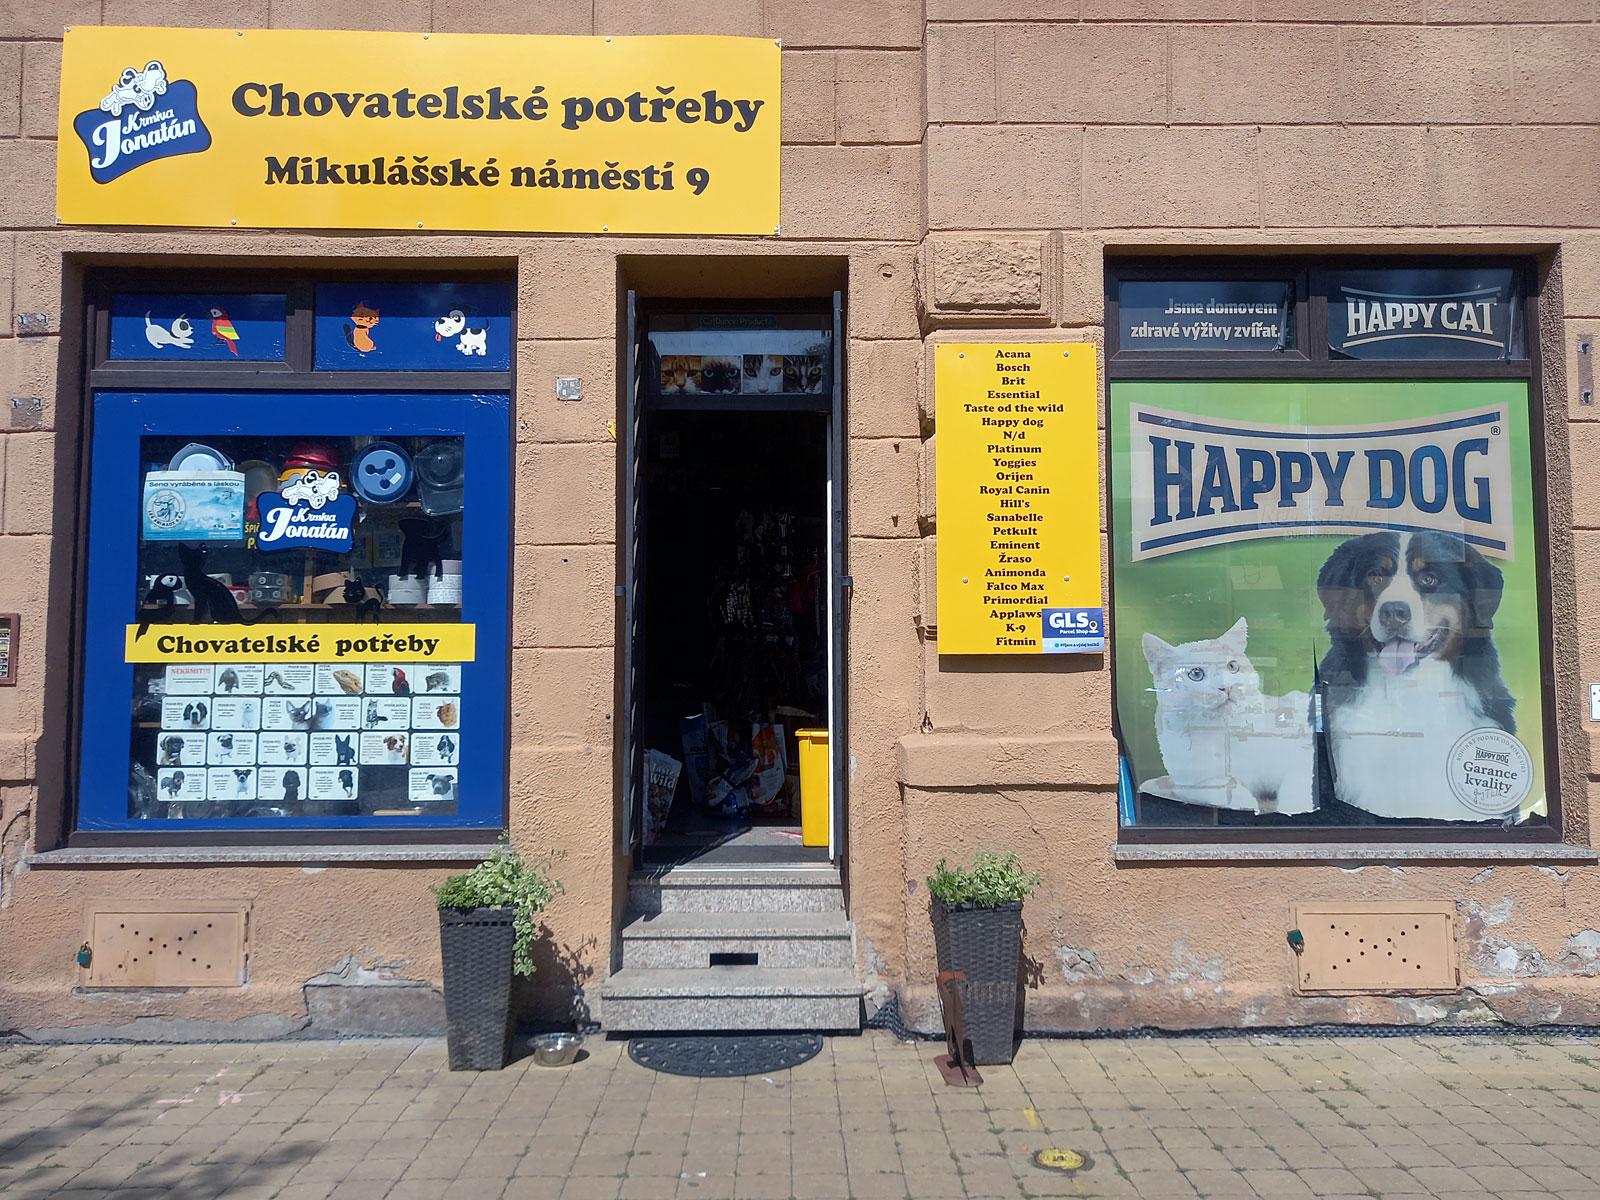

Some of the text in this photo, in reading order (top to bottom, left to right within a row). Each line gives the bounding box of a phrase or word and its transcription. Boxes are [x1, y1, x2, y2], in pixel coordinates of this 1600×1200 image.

[231, 82, 765, 133] Chovatelské potřeby
[122, 109, 175, 135] Krmiva
[91, 118, 197, 169] Jonatán
[264, 156, 711, 195] Mikulášské náměstí 9
[1164, 298, 1278, 314] Jsme domovem
[1346, 296, 1498, 337] HAPPY CAT
[1131, 321, 1180, 338] zdravé
[1182, 321, 1233, 341] výživy
[995, 350, 1031, 359] Acana
[996, 363, 1031, 372] Bosch
[1001, 377, 1026, 385] Brit
[987, 390, 1040, 399] Essential
[963, 404, 1064, 413] Taste od the wild
[981, 417, 1044, 428] Happy dog
[1003, 431, 1026, 441] N/d
[987, 445, 1042, 454] Platinum
[993, 458, 1037, 469] Yoggies
[996, 472, 1034, 483] Orijen
[1148, 435, 1493, 527] HAPPY DOG
[979, 485, 1050, 496] Royal Canin
[1000, 499, 1030, 508] Hill's
[291, 506, 337, 523] Krmiva
[986, 513, 1044, 522] Sanabelle
[259, 507, 349, 542] Jonatán
[993, 527, 1038, 536] Petkult
[990, 541, 1041, 550] Eminent
[998, 552, 1032, 563] Žraso
[984, 568, 1046, 577] Animonda
[986, 582, 1045, 591] Falco Max
[983, 596, 1048, 605] Primordial
[989, 609, 1042, 620] Applaws
[1049, 611, 1089, 629] GLS
[1005, 624, 1026, 633] K-9
[156, 633, 440, 656] Chovatelské potřeby
[995, 637, 1037, 646] Fitmin
[1475, 749, 1510, 764] HAPPY DOG
[1463, 761, 1518, 780] Garance
[1464, 773, 1513, 794] kvality
